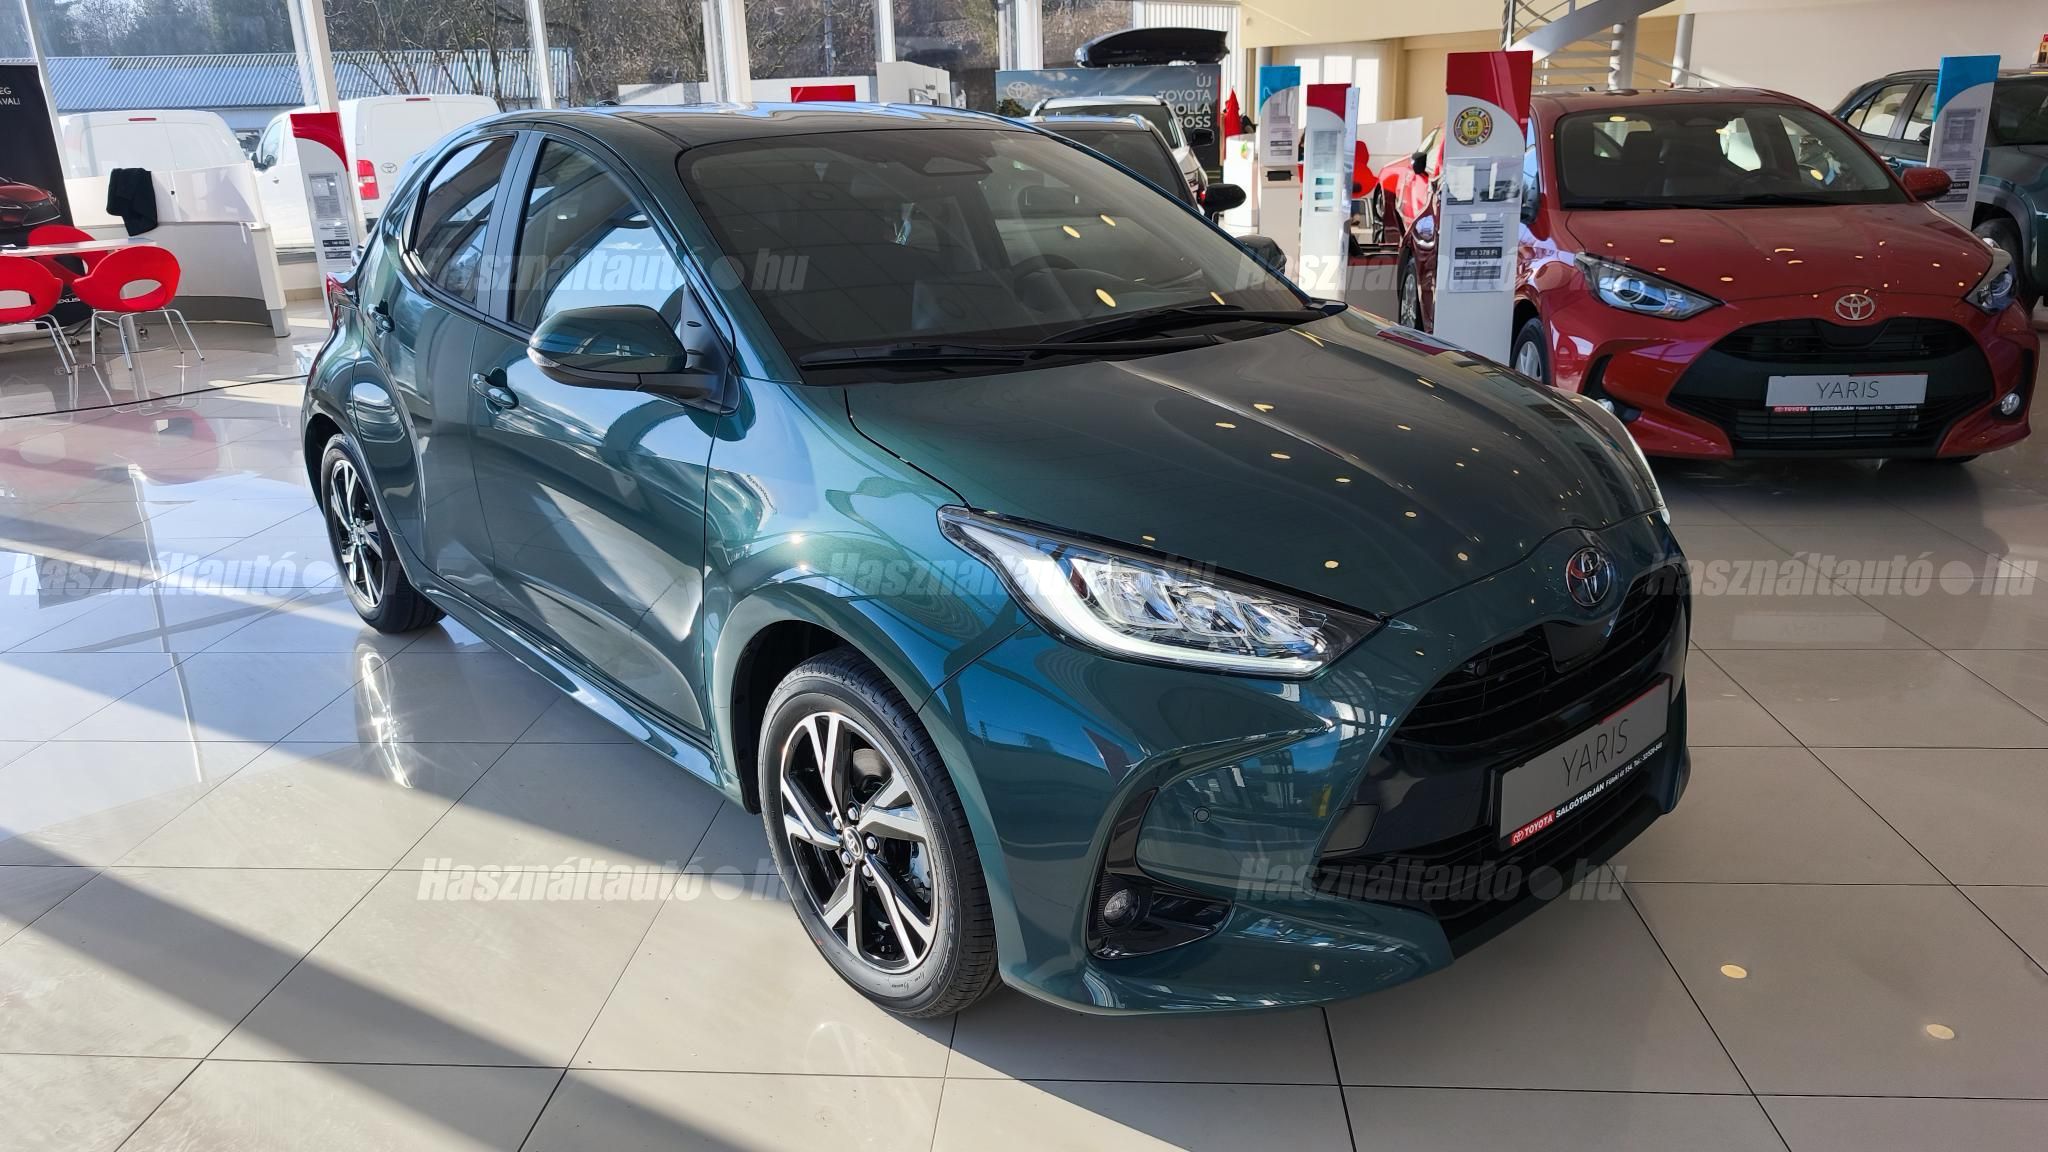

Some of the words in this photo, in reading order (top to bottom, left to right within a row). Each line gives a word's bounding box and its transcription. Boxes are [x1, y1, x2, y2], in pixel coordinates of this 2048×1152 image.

[1196, 72, 1212, 88] ÚJ
[1158, 89, 1212, 102] TOYOTA
[1170, 102, 1212, 115] OLLA
[1177, 115, 1212, 128] ROSS
[1816, 380, 1880, 399] YARIS
[1563, 718, 1629, 787] YARIS
[1524, 814, 1553, 836] TOYOTA
[1556, 782, 1604, 818] SALGÓTARJÁN
